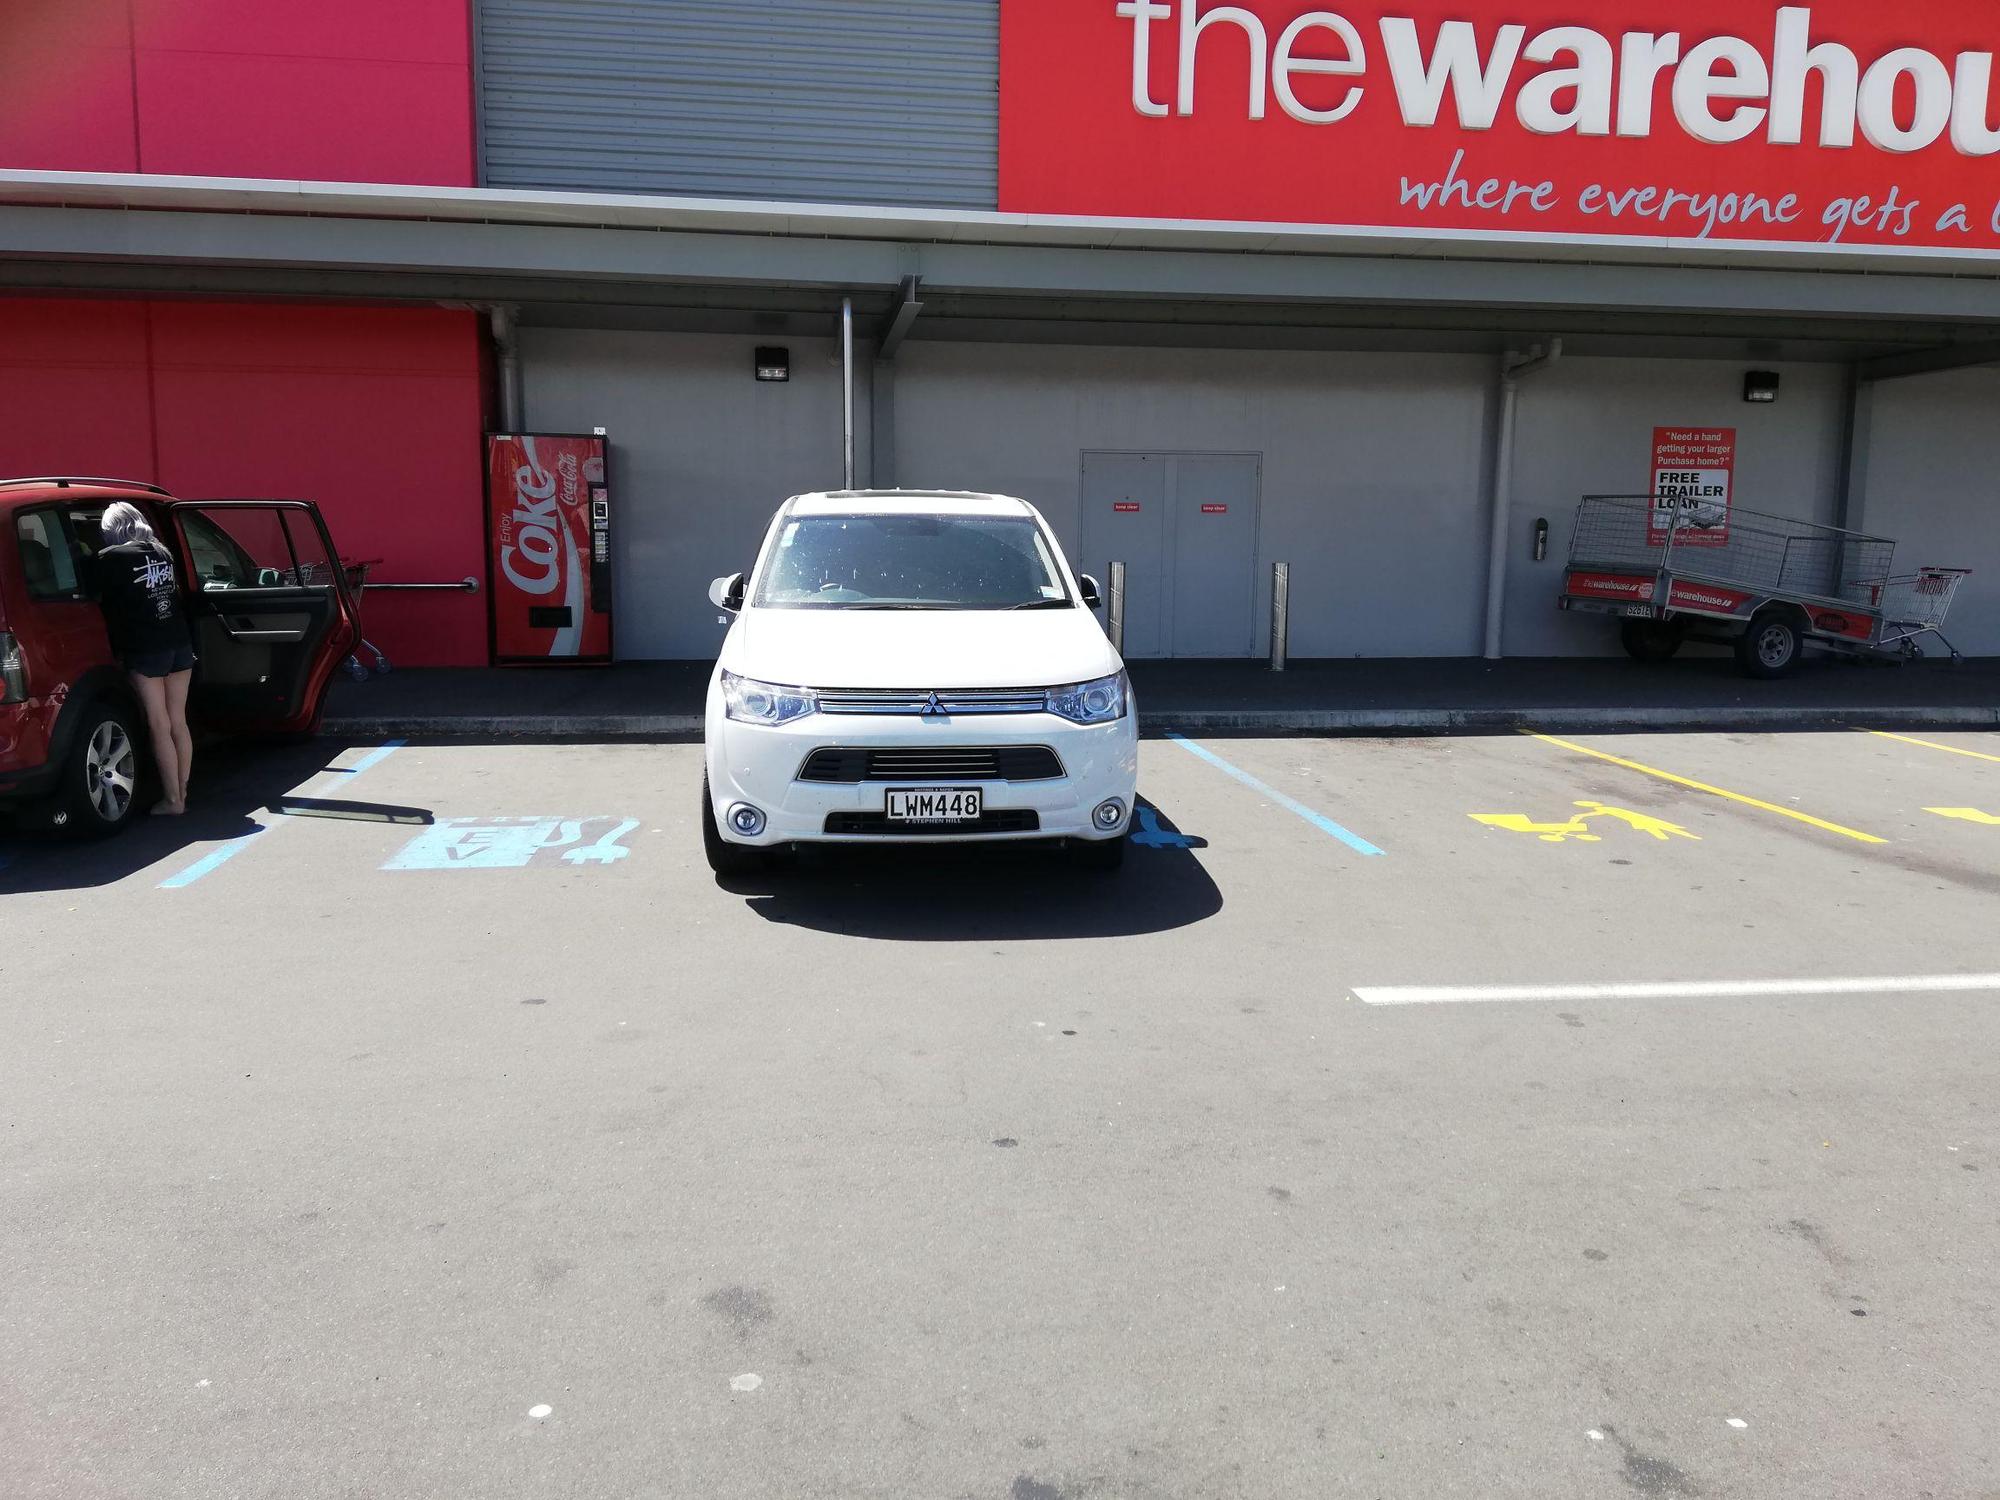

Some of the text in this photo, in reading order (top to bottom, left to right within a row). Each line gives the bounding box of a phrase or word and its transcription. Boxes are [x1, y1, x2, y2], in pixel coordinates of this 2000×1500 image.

[1116, 0, 1366, 125] the
[1400, 149, 1560, 213] where
[1579, 183, 1803, 238] everyone
[1822, 186, 1920, 244] gets
[1935, 203, 1974, 232] a
[1701, 432, 1722, 441] hand
[1656, 444, 1731, 454] getting your larger
[1657, 456, 1695, 465] Purchase
[1659, 472, 1700, 483] FREE
[1658, 485, 1724, 497] TRAILER
[1658, 498, 1699, 509] LOAN
[500, 512, 512, 543] Enjoy
[501, 465, 560, 595] Coke
[1593, 580, 1629, 591] warehouse
[1677, 591, 1722, 606] warehouse
[890, 794, 978, 817] LWM448
